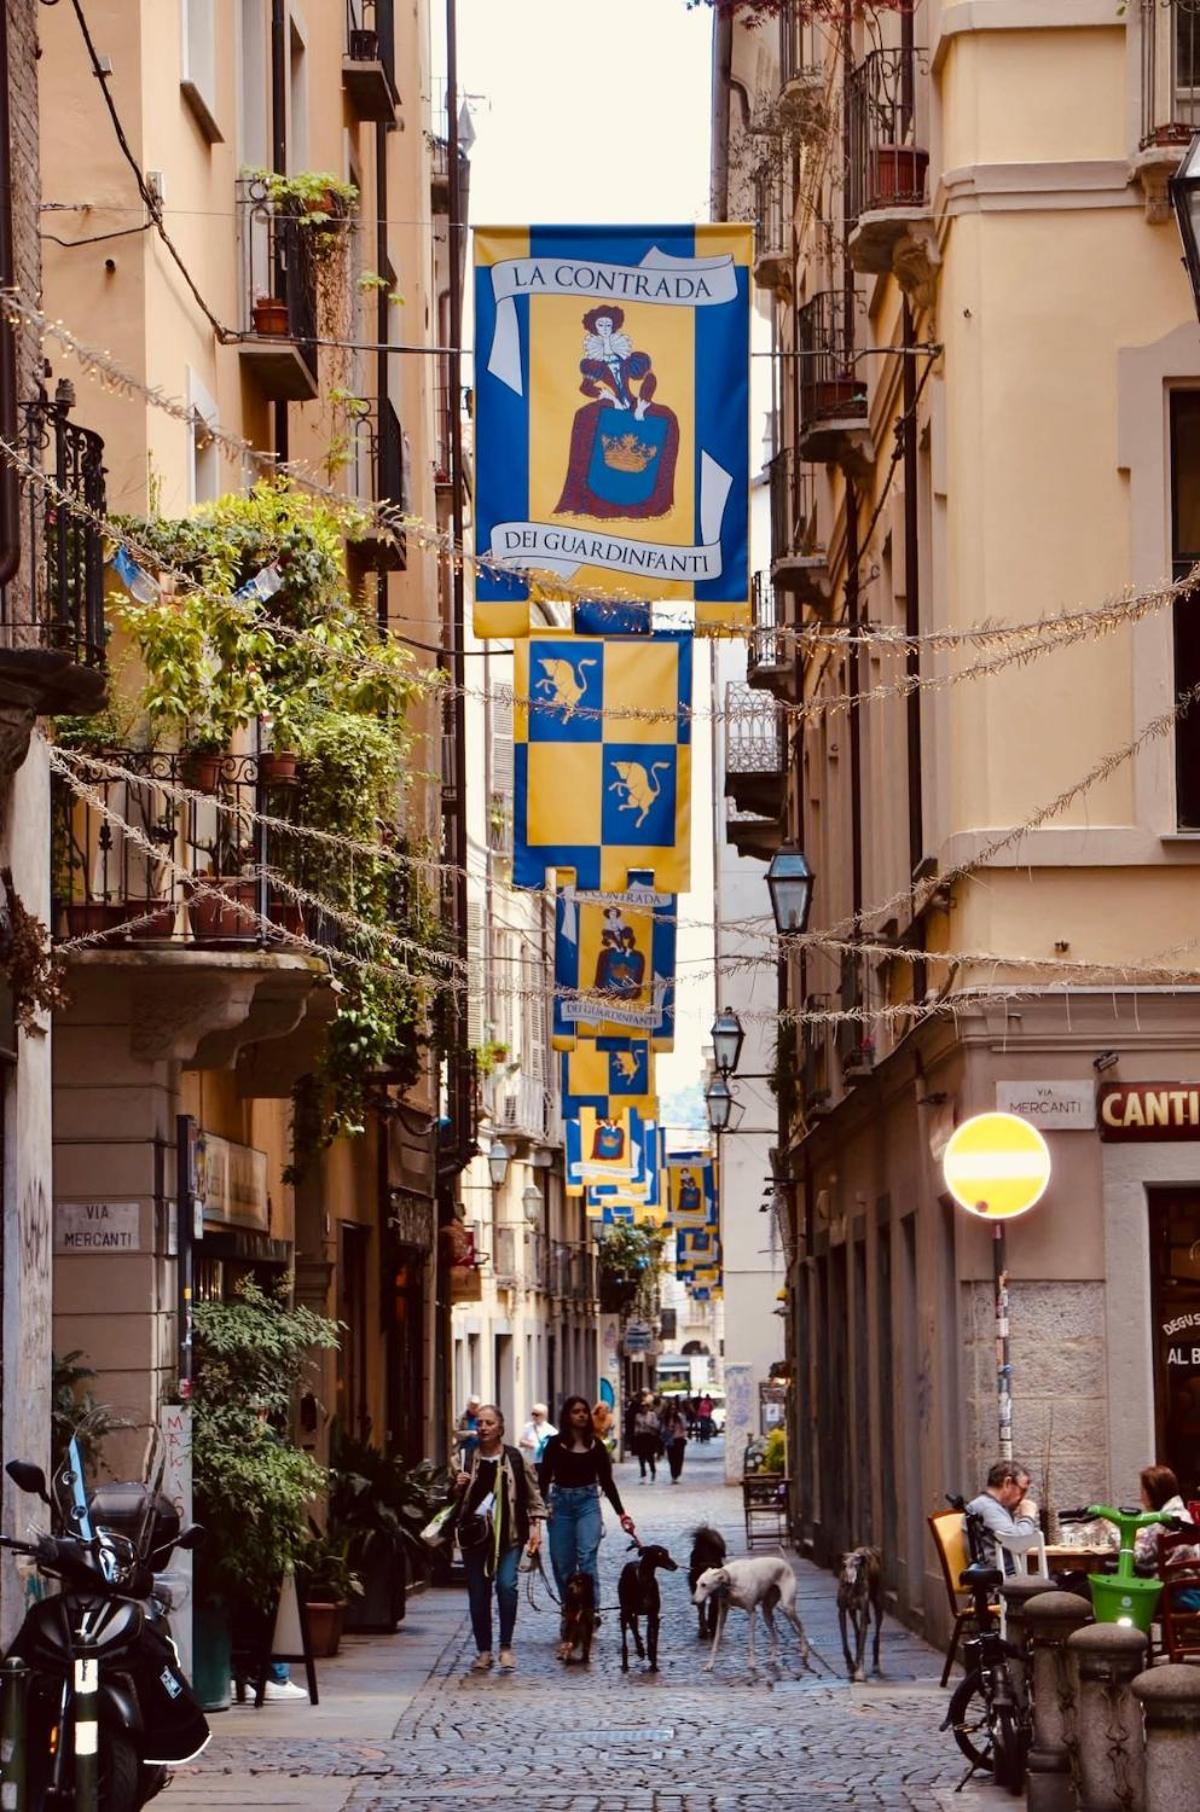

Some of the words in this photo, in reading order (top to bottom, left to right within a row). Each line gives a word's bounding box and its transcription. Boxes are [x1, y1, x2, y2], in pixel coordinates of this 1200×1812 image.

[513, 265, 546, 287] LA
[555, 265, 712, 298] CONTRADA
[504, 531, 537, 549] DEI
[544, 532, 709, 573] GUARDINFANTI
[1037, 1088, 1053, 1096] VIA
[1010, 1101, 1081, 1114] MERCANTI
[1102, 1091, 1199, 1127] CANTI
[86, 1205, 109, 1219] VIA
[64, 1232, 132, 1247] MERCANTI
[1167, 1347, 1189, 1365] AL
